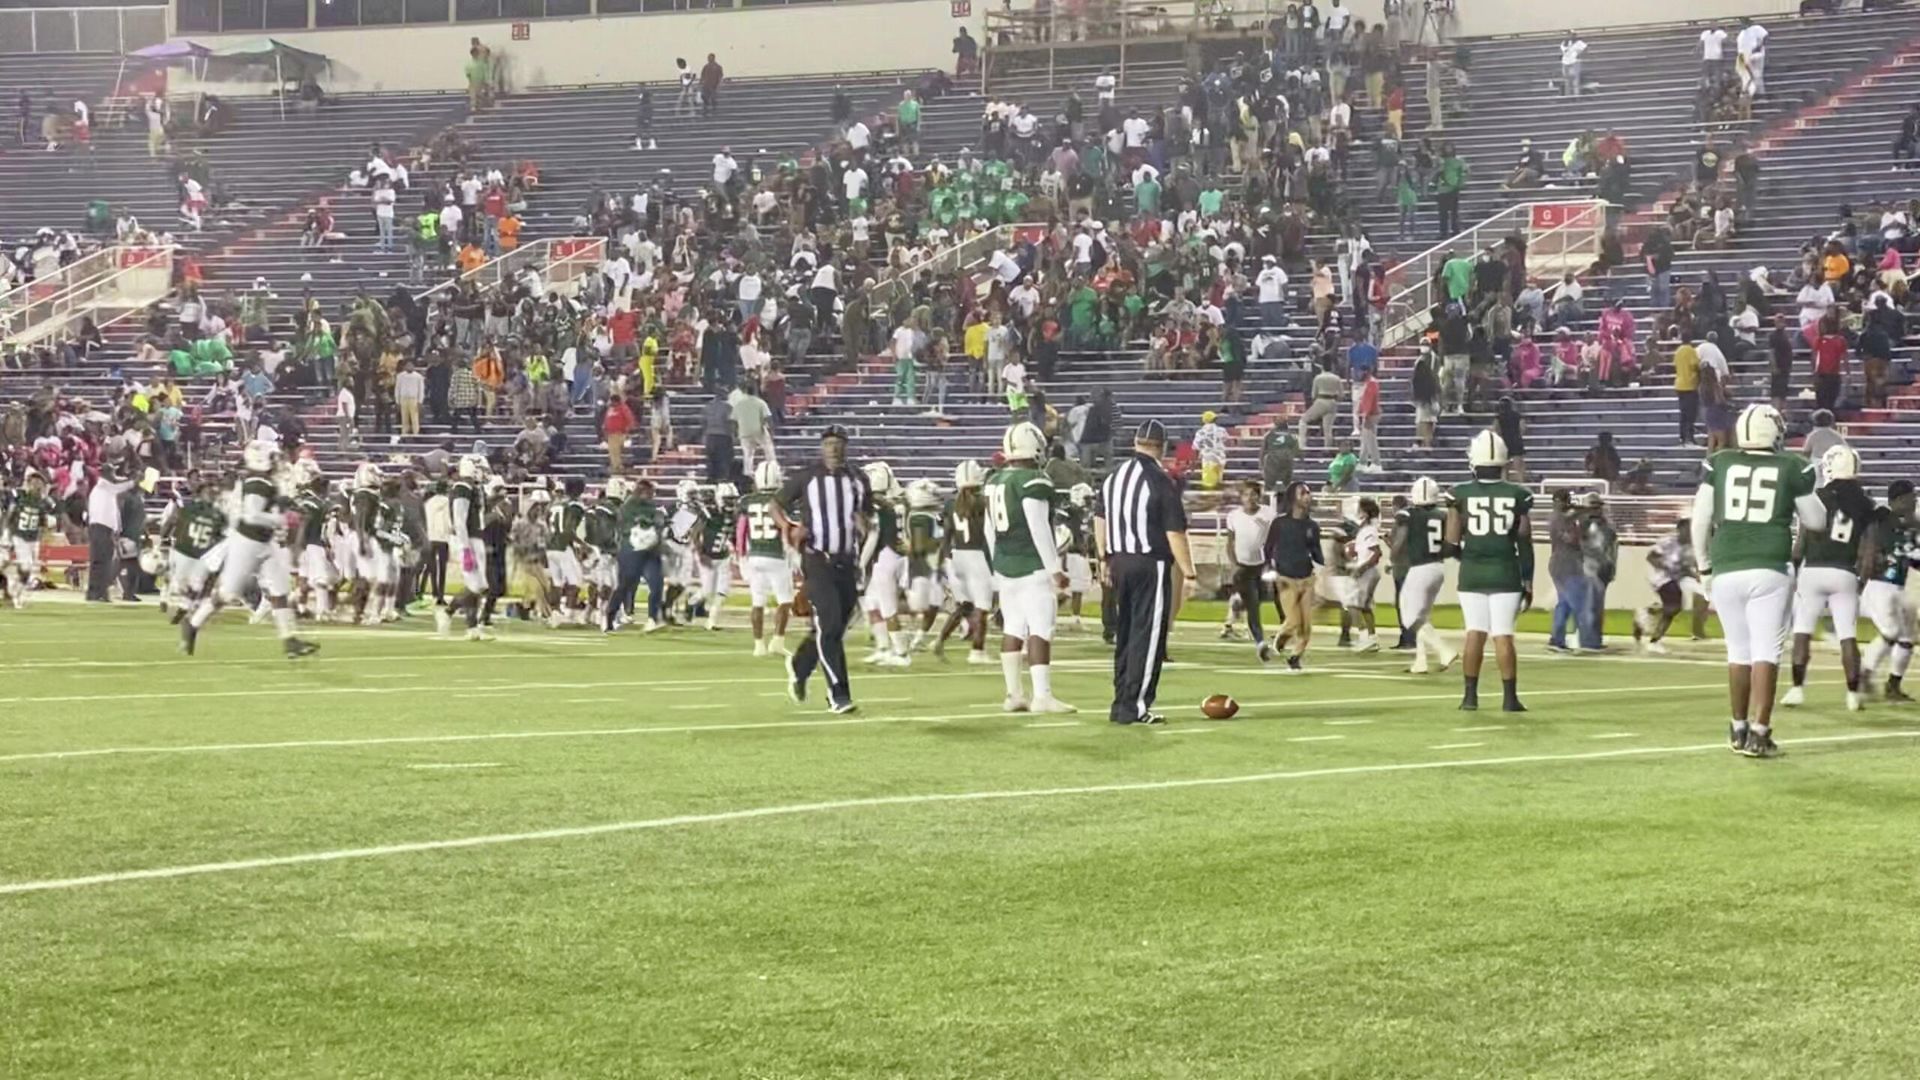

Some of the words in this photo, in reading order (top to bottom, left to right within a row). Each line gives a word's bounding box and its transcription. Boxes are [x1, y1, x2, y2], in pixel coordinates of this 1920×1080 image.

[1542, 210, 1552, 221] G
[1724, 465, 1779, 523] 65
[1467, 497, 1516, 536] 55
[188, 521, 213, 549] 45
[1427, 519, 1442, 553] 2
